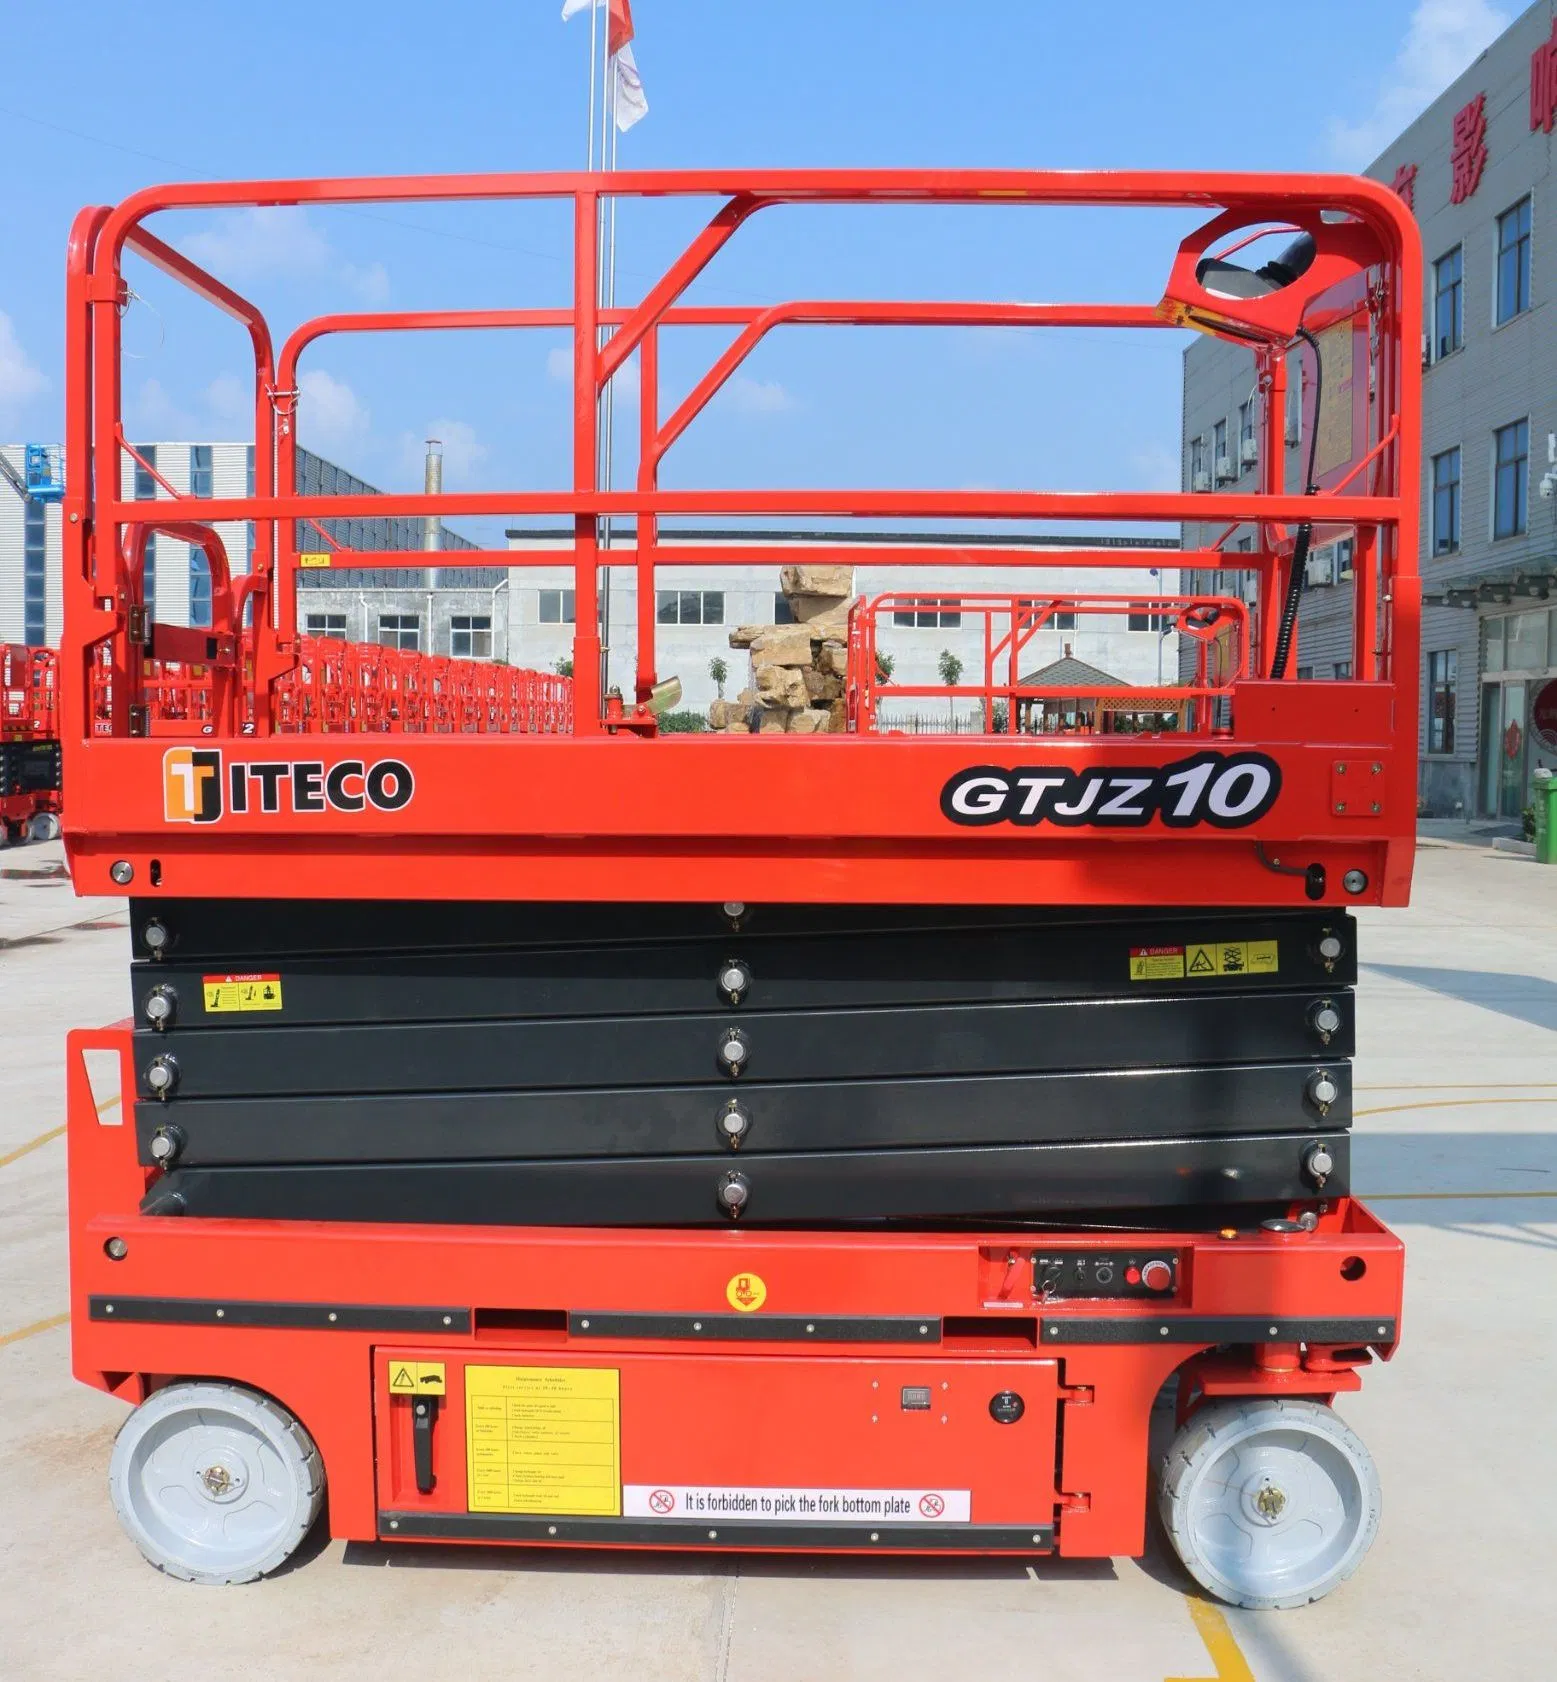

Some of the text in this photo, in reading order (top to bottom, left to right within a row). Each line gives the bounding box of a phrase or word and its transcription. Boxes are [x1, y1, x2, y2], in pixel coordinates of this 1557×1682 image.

[230, 759, 415, 813] ITECO
[1149, 947, 1178, 956] DANGER
[234, 974, 263, 982] DANGER
[685, 1492, 911, 1518] It is forbidden to pick the fork bottom plate
